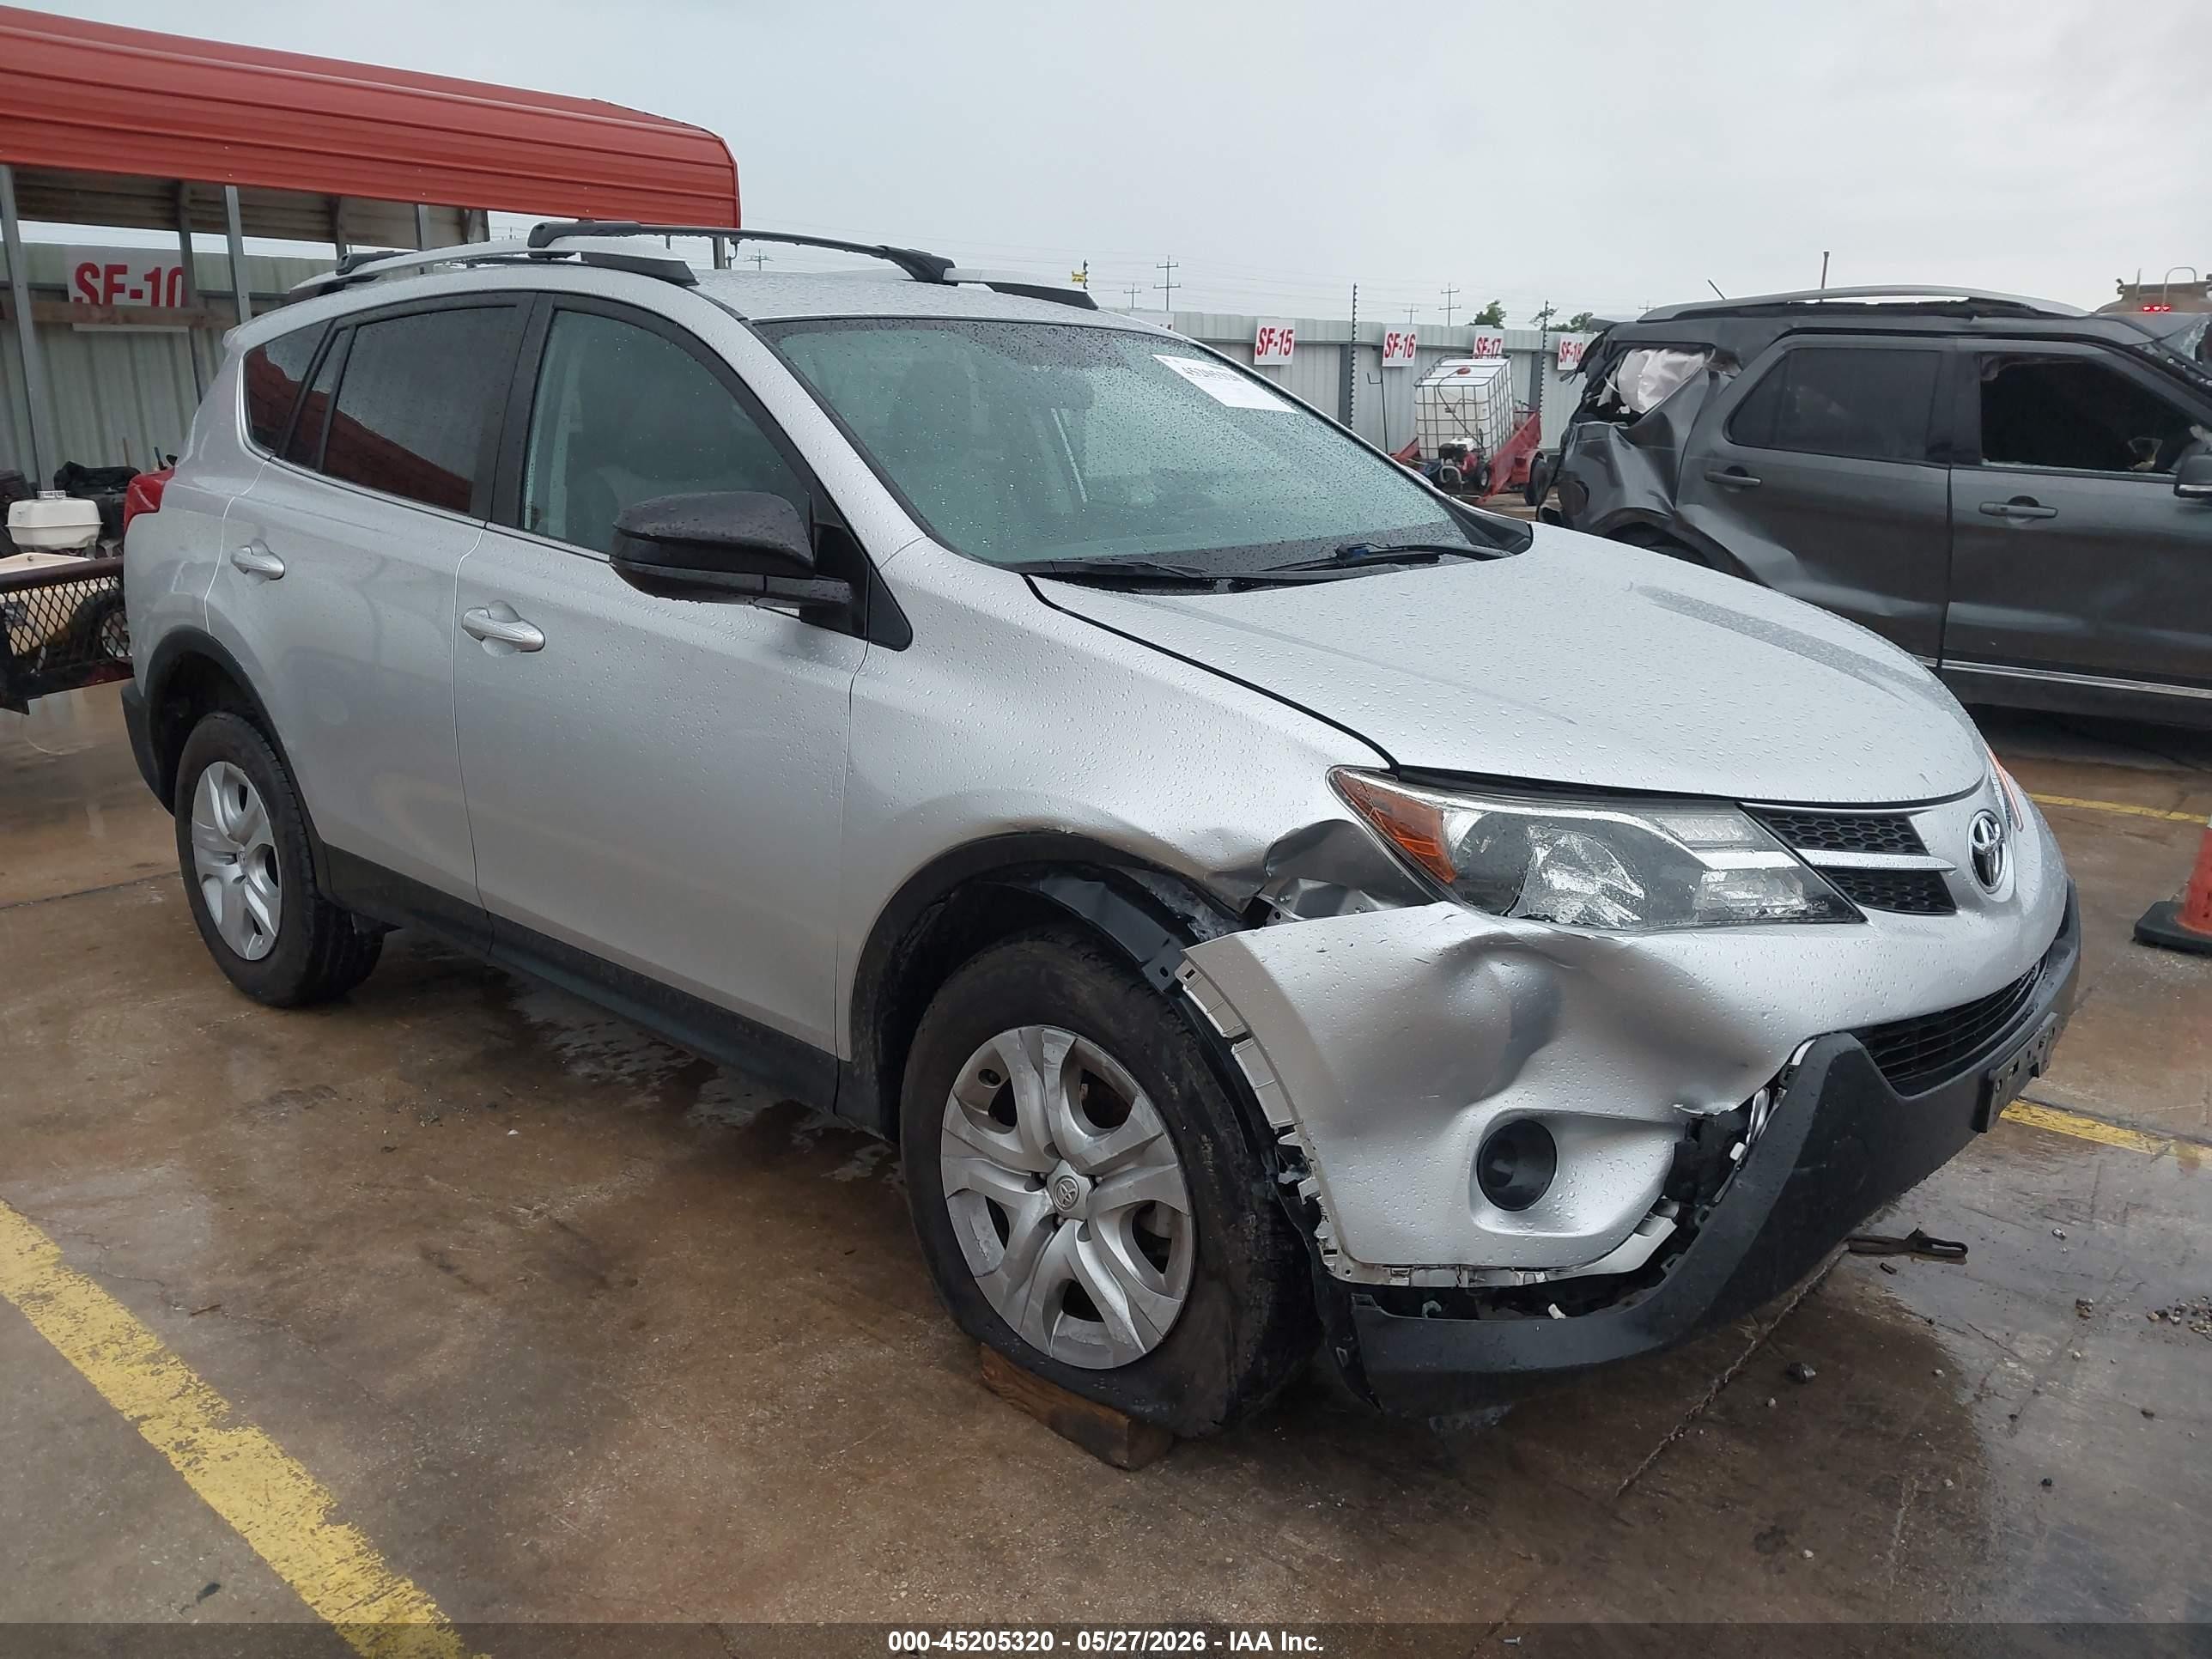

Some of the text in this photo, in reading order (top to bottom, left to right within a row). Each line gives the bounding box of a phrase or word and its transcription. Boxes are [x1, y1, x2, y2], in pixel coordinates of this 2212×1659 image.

[74, 262, 188, 308] SF-10
[1255, 328, 1294, 356] SF-15
[1384, 332, 1416, 359] SF-16
[1474, 336, 1502, 359] SF-17
